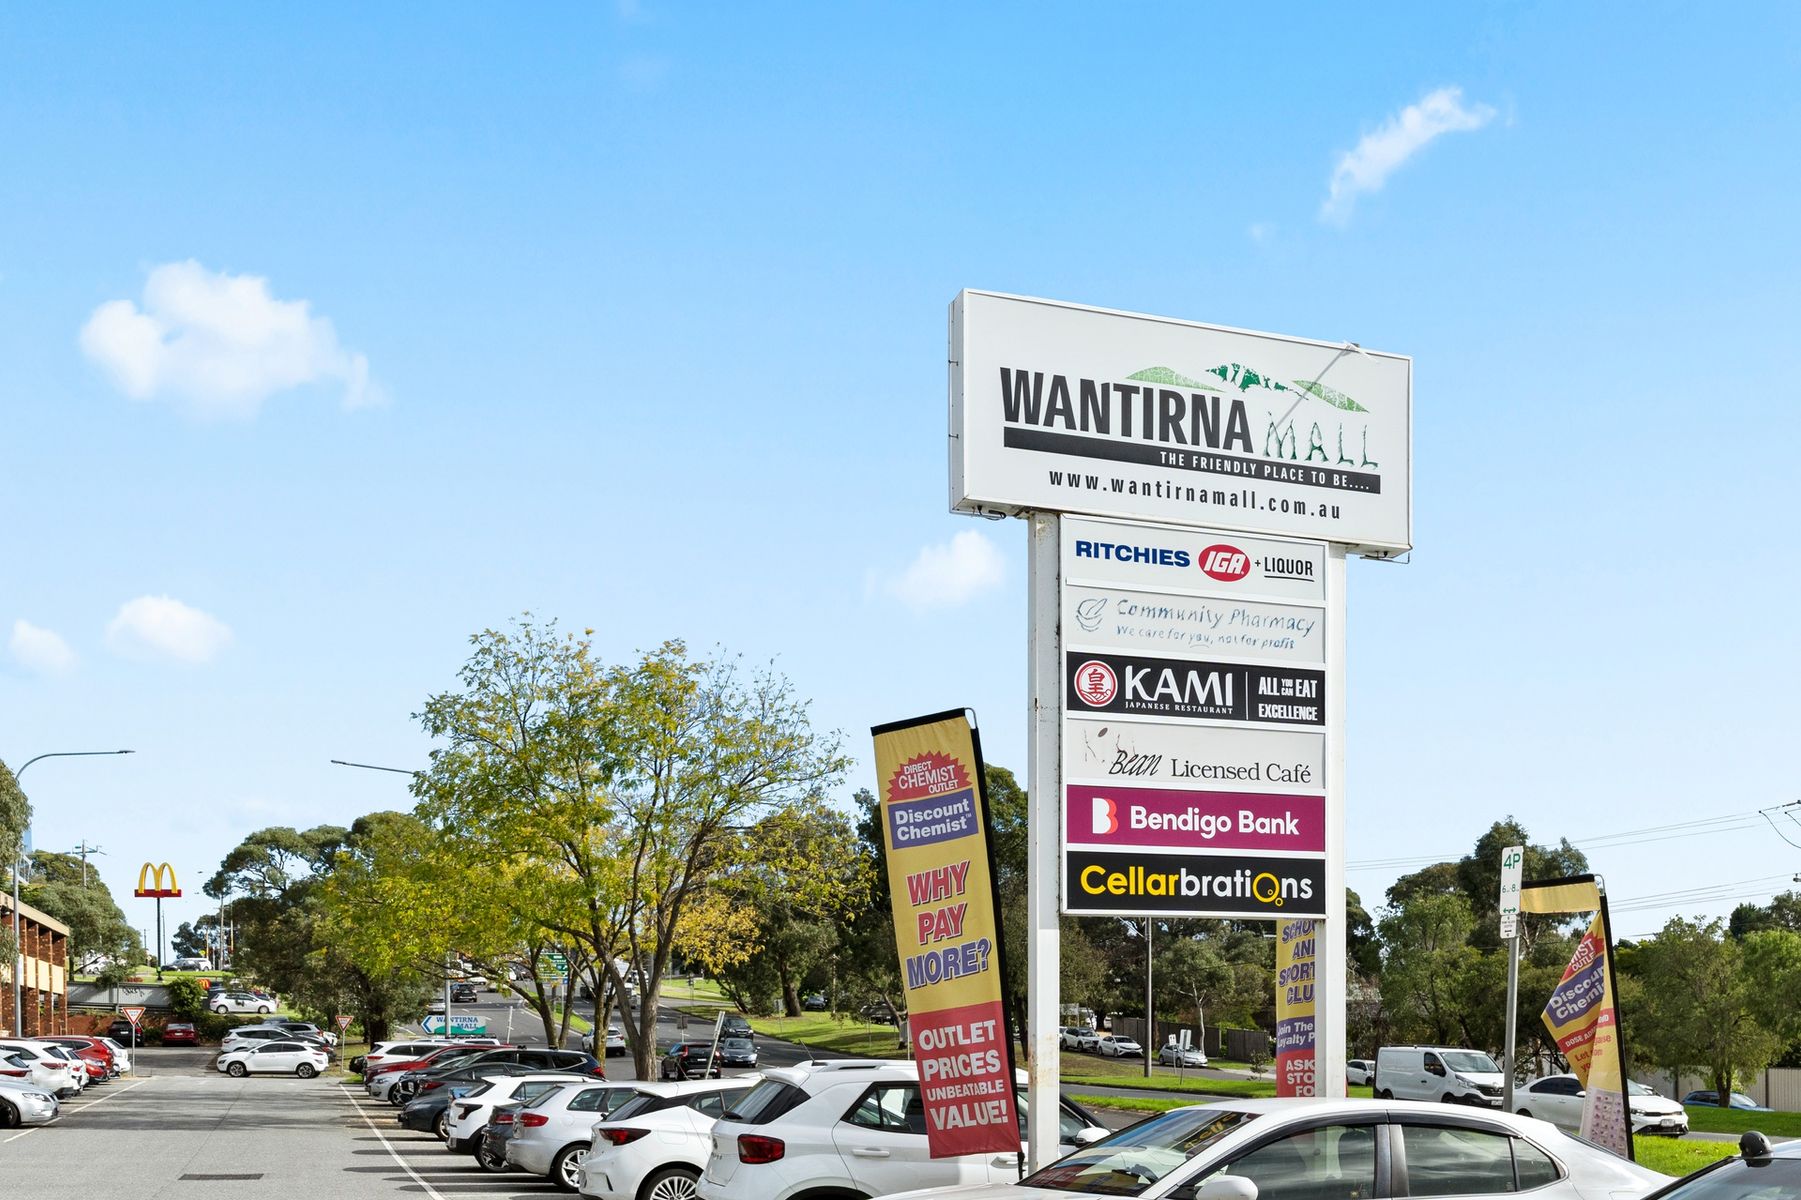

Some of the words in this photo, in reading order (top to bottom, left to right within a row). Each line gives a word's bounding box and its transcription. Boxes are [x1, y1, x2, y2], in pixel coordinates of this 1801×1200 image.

[999, 367, 1254, 453] WANTIRNA
[1262, 410, 1380, 469] MALL
[1159, 451, 1186, 467] THE
[1192, 455, 1257, 476] FRIENDLY
[1264, 464, 1305, 482] PLACE
[1311, 469, 1327, 485] TO
[1049, 470, 1341, 520] www.wantirnamall.com.au
[1075, 540, 1191, 568] RITCHIES
[1203, 550, 1246, 575] IGA
[1264, 556, 1314, 577] LIQUOR
[1116, 599, 1225, 630] Community
[1229, 608, 1316, 638] Pharmacy
[1138, 628, 1165, 638] care
[1166, 626, 1186, 641] for
[1125, 665, 1233, 707] KAMI
[1258, 676, 1278, 696] ALL
[1281, 678, 1294, 687] YOU
[1295, 679, 1318, 698] EAT
[1281, 686, 1294, 696] CAN
[1125, 701, 1170, 712] JAPANESE
[1174, 703, 1234, 715] RESTAURANT
[1258, 703, 1318, 721] EXCELLENCE
[898, 764, 956, 790] CHEMIST
[903, 760, 932, 775] DIRECT
[1109, 748, 1162, 777] Bean
[1171, 758, 1260, 781] Licensed
[1266, 763, 1312, 784] Café
[928, 779, 959, 794] OUTLET
[895, 798, 970, 826] Discount
[897, 815, 968, 841] Chemist
[1130, 805, 1232, 839] Bendigo
[1238, 810, 1300, 835] Bank
[1503, 853, 1521, 870] 4P
[906, 860, 970, 907] WHY
[1080, 864, 1313, 906] Cellarbrations
[917, 903, 968, 945] PAY
[906, 938, 991, 990] MORE?
[918, 1019, 996, 1051] OUTLET
[1294, 1022, 1313, 1033] The
[922, 1050, 1001, 1082] PRICES
[926, 1079, 1005, 1102] UNBEATABLE
[929, 1099, 1009, 1131] VALUE!
